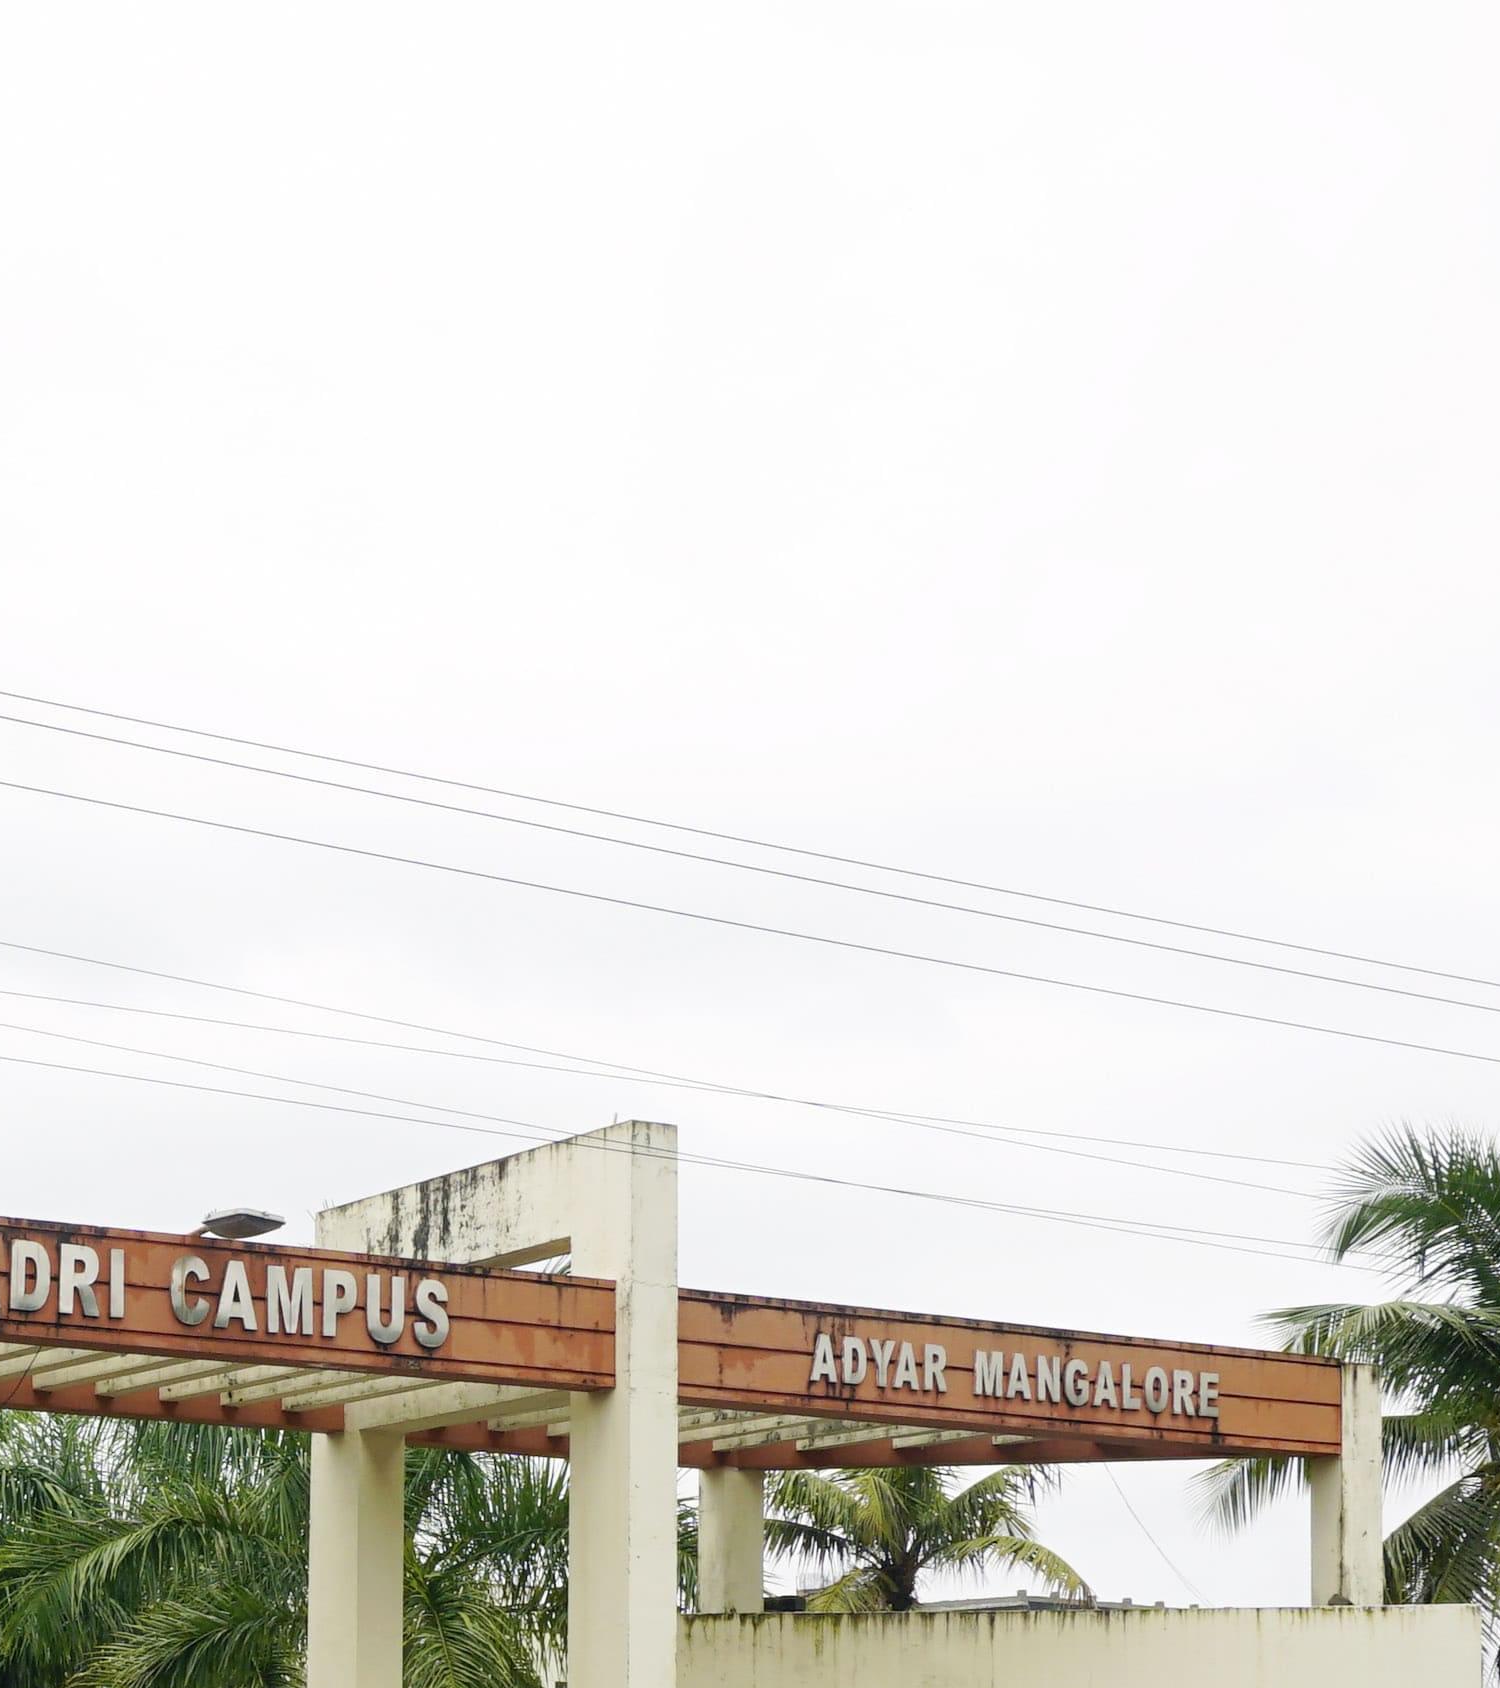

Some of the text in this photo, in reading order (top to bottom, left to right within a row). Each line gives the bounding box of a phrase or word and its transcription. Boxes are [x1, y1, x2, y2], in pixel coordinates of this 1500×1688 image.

[171, 1255, 449, 1349] CAMPUS
[810, 1333, 1219, 1418] ADYAR MANGALORE
